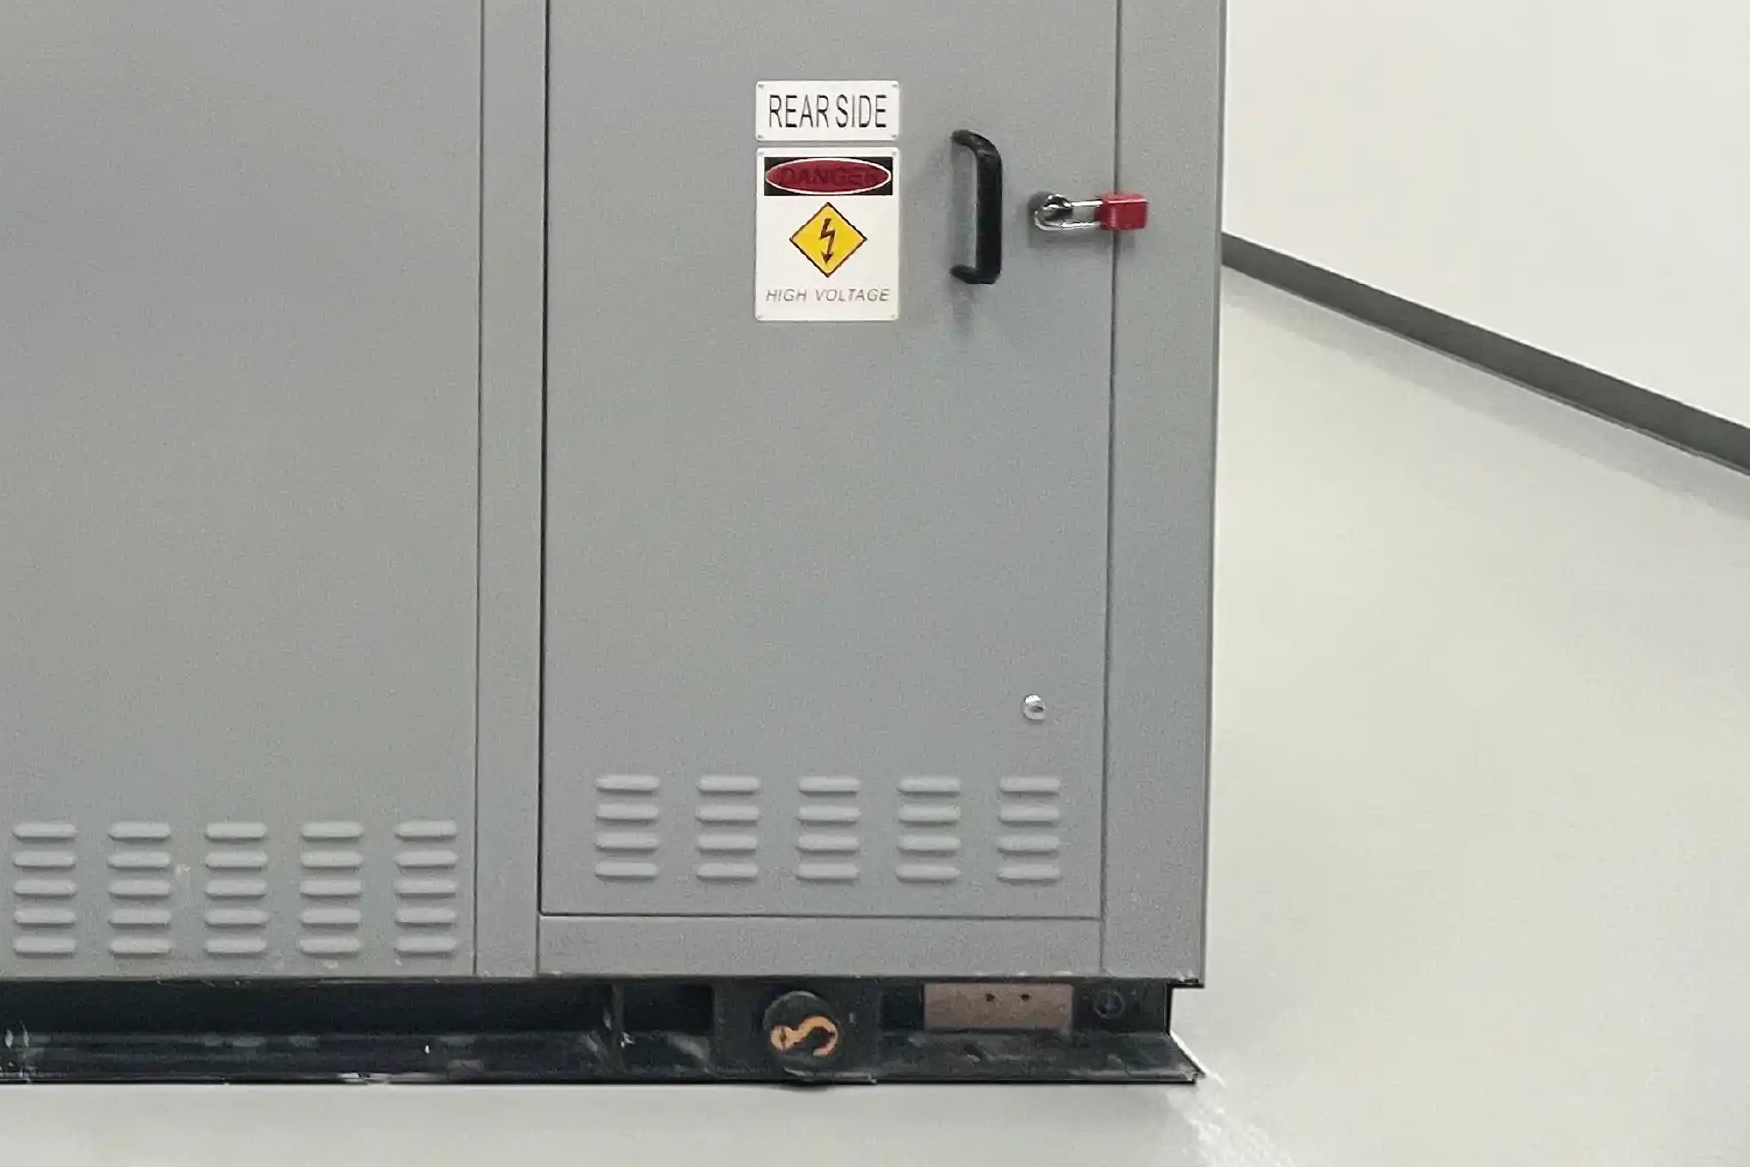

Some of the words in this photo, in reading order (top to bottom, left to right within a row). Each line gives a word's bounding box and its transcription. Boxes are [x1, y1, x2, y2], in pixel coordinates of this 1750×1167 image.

[769, 94, 830, 128] REAR
[835, 94, 887, 129] SIDE
[765, 289, 807, 302] HIGH
[815, 288, 890, 302] VOLTAGE
